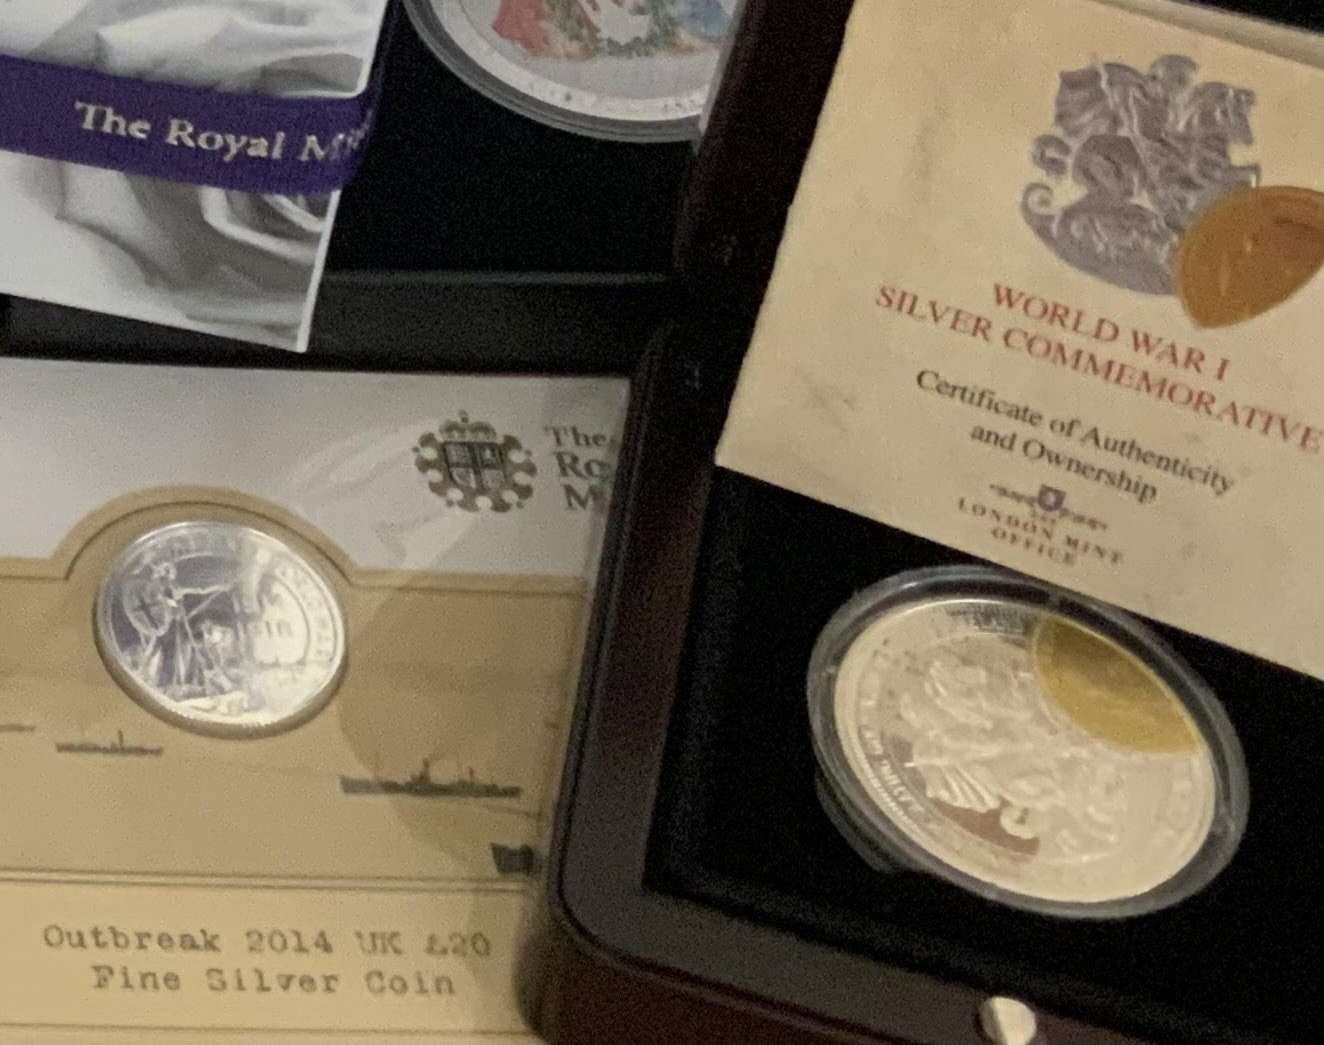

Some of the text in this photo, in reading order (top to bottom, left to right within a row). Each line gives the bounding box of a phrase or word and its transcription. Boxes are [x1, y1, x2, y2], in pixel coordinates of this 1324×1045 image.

[75, 99, 152, 140] The
[163, 115, 288, 164] Royal
[992, 281, 1232, 383] WORLD WAR I
[873, 284, 1323, 456] SILVER COMMEMORATIVE
[544, 424, 608, 448] The
[915, 367, 1236, 498] Certificate of Authenticity
[969, 423, 1159, 505] and Ownership
[957, 496, 1053, 542] LONDON
[1064, 534, 1124, 566] MINT
[990, 526, 1076, 567] OFFICE
[42, 924, 223, 955] Outbreak
[244, 927, 335, 956] 2014
[353, 929, 403, 956] UK
[90, 964, 458, 998] Fine Silver Coin
